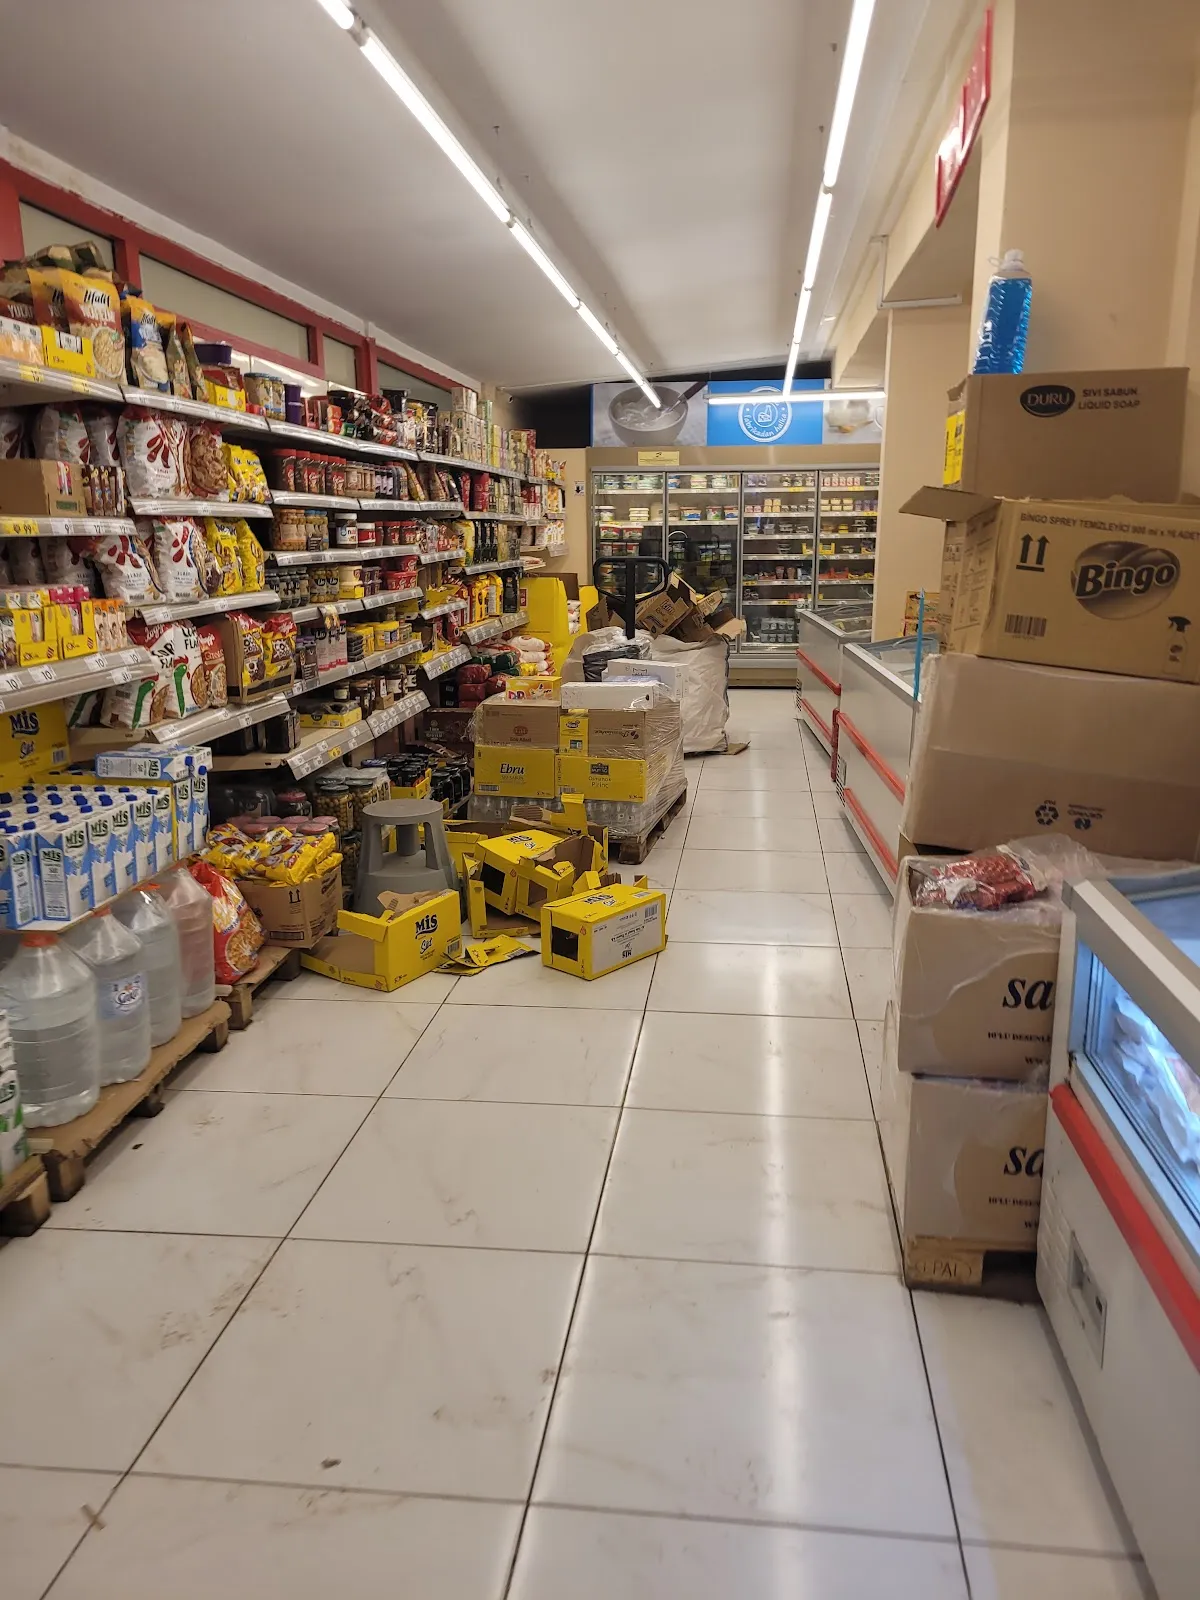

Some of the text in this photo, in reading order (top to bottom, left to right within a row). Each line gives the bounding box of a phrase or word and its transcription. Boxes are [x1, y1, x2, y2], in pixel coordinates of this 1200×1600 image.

[1103, 387, 1138, 397] SABUN
[1027, 393, 1070, 406] DURU
[1112, 399, 1140, 409] SOAP
[1049, 516, 1077, 528] SPREY
[1076, 560, 1175, 598] Bingo
[41, 670, 52, 680] 10
[7, 680, 18, 690] 10
[500, 763, 525, 775] Ebru
